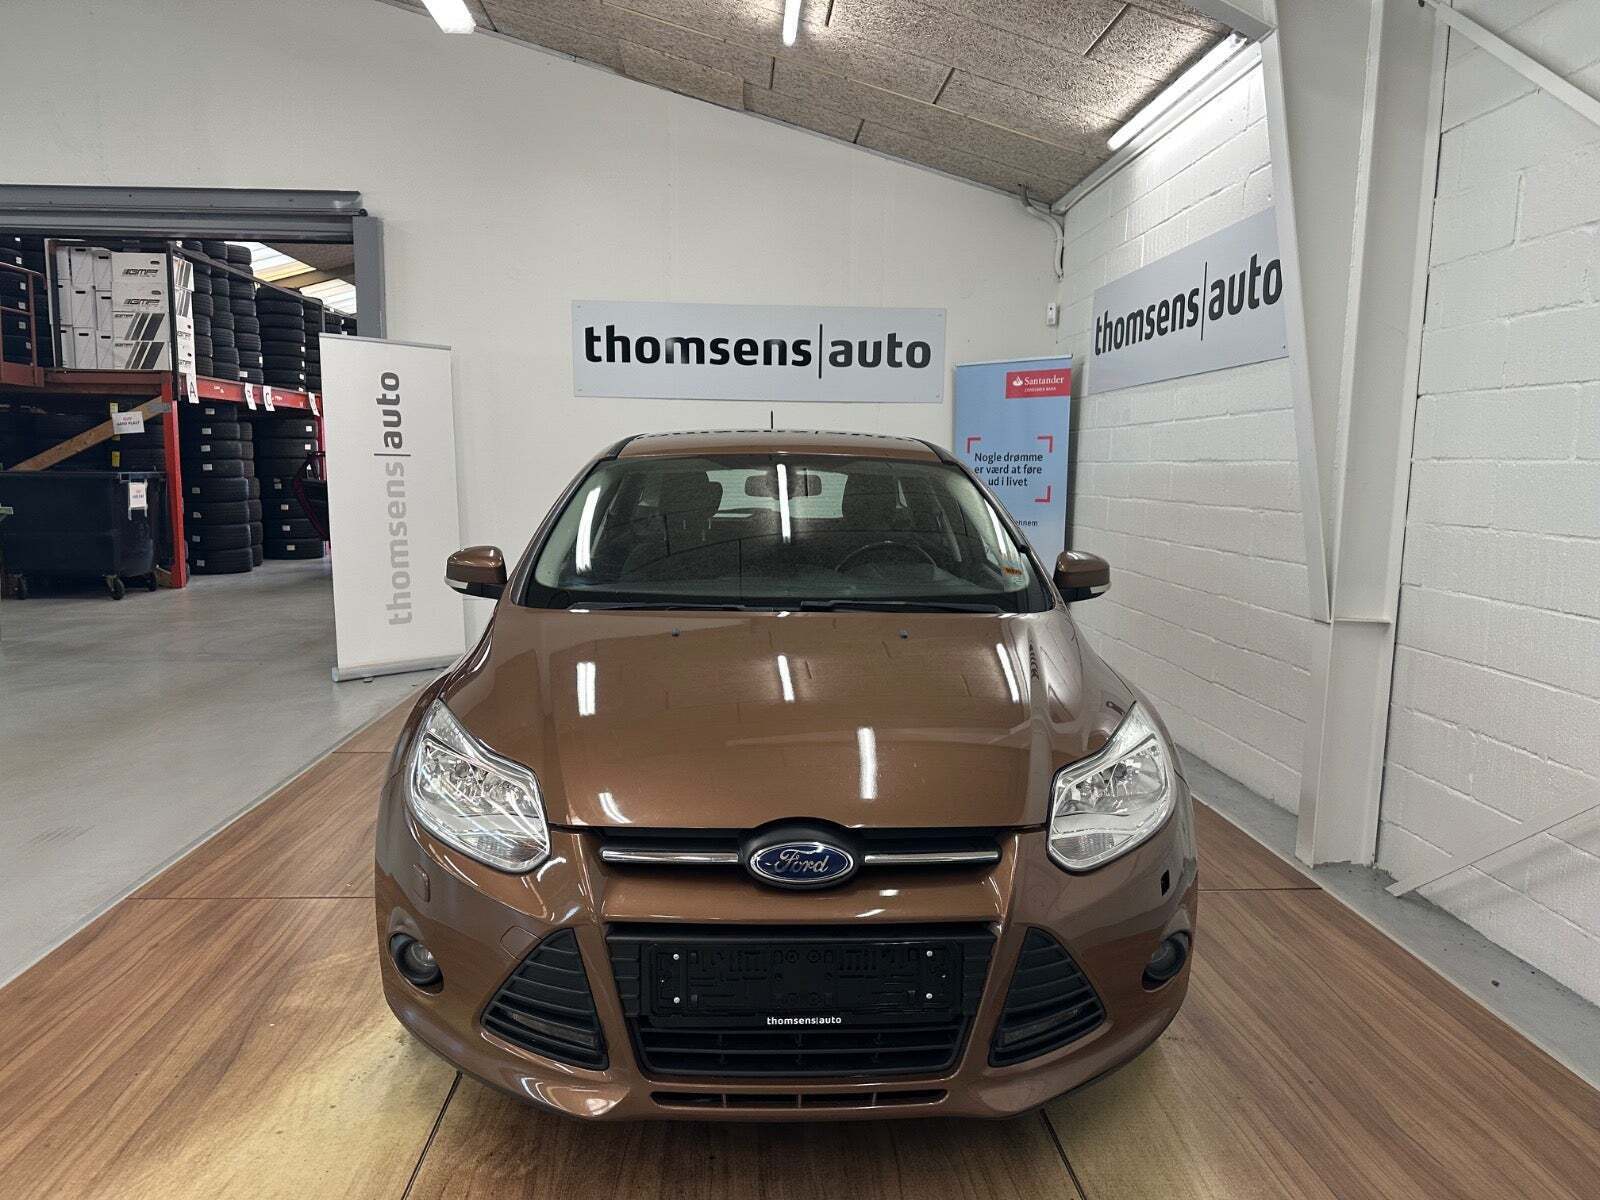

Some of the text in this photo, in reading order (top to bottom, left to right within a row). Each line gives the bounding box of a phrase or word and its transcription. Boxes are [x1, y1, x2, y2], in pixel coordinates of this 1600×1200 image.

[1024, 374, 1065, 387] Santander
[974, 451, 1043, 465] Nogle drømme
[974, 464, 1042, 474] er værd at føre
[988, 477, 1000, 486] ud
[1006, 477, 1028, 486] livet
[768, 848, 829, 873] Ford
